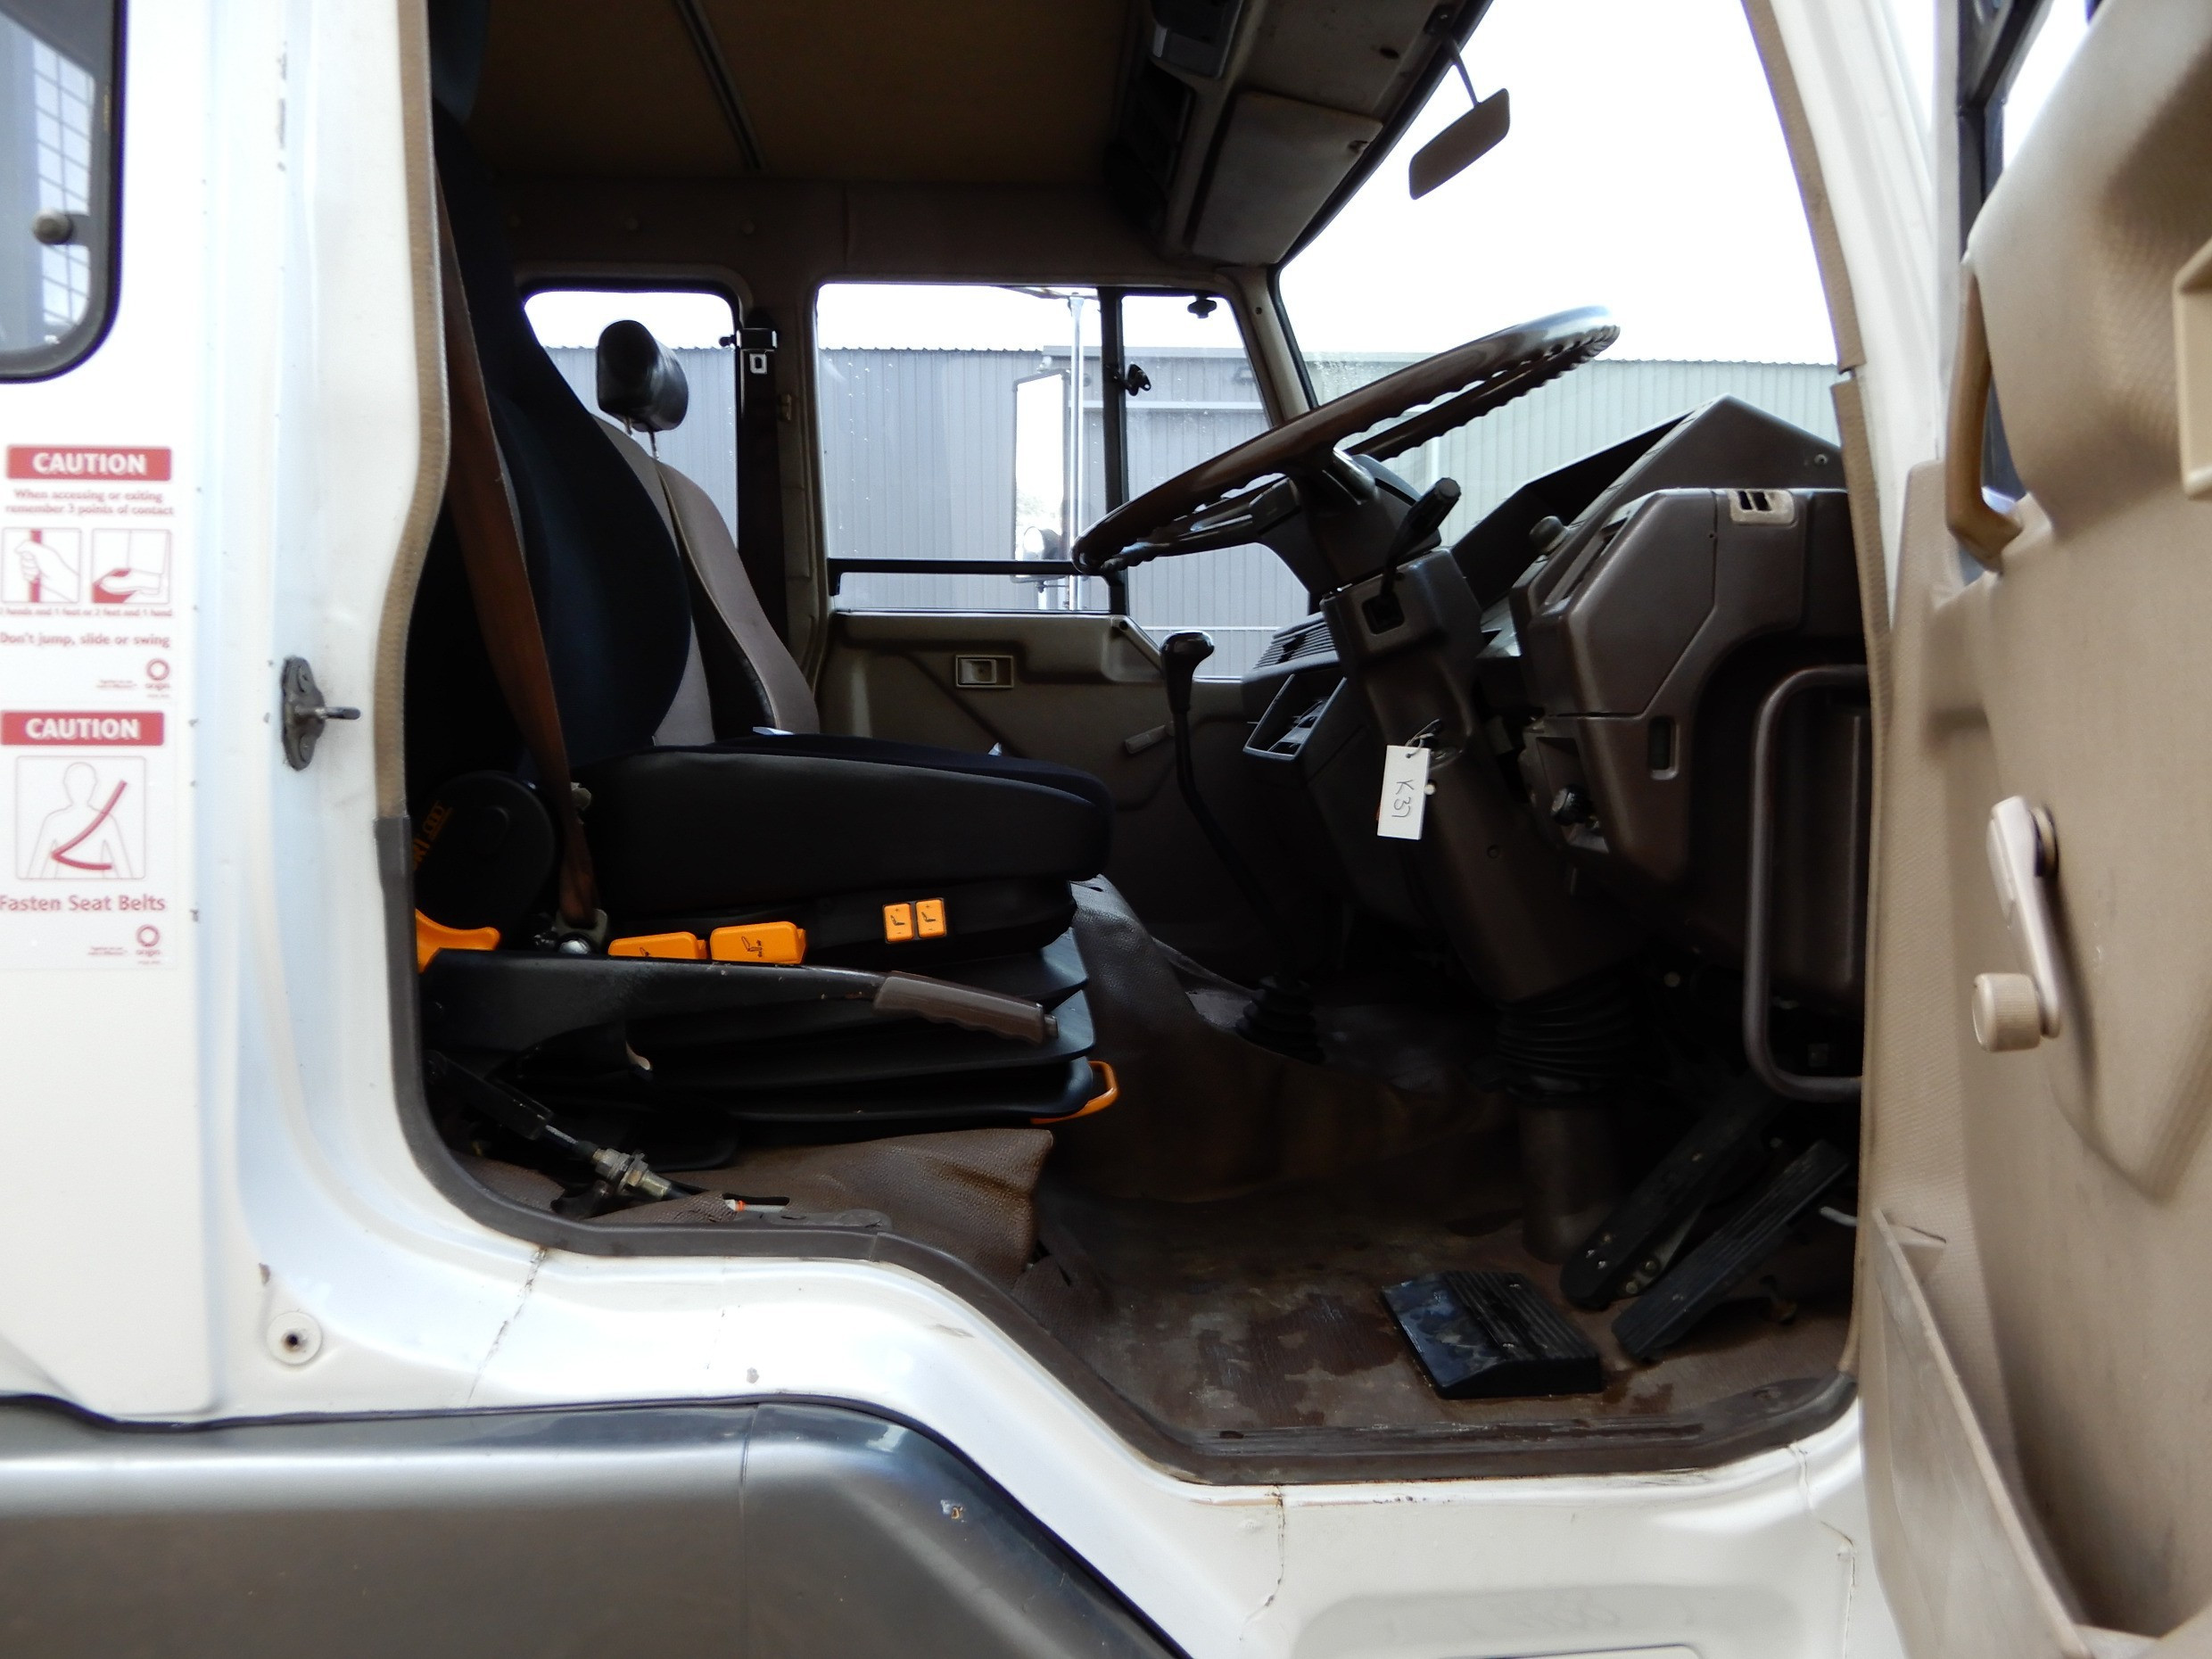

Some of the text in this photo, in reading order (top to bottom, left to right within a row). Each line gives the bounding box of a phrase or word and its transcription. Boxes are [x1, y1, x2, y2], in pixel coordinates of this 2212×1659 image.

[32, 452, 147, 475] CAUTION
[13, 489, 48, 499] When
[52, 490, 104, 502] accessing
[125, 490, 162, 504] exiting
[5, 503, 65, 513] remember
[78, 504, 113, 516] points
[117, 504, 128, 514] of
[132, 506, 174, 515] contact
[0, 631, 170, 648] Don't jump, slide or swing
[25, 717, 141, 740] CAUTION
[0, 895, 166, 911] Fasten Seat Belts
